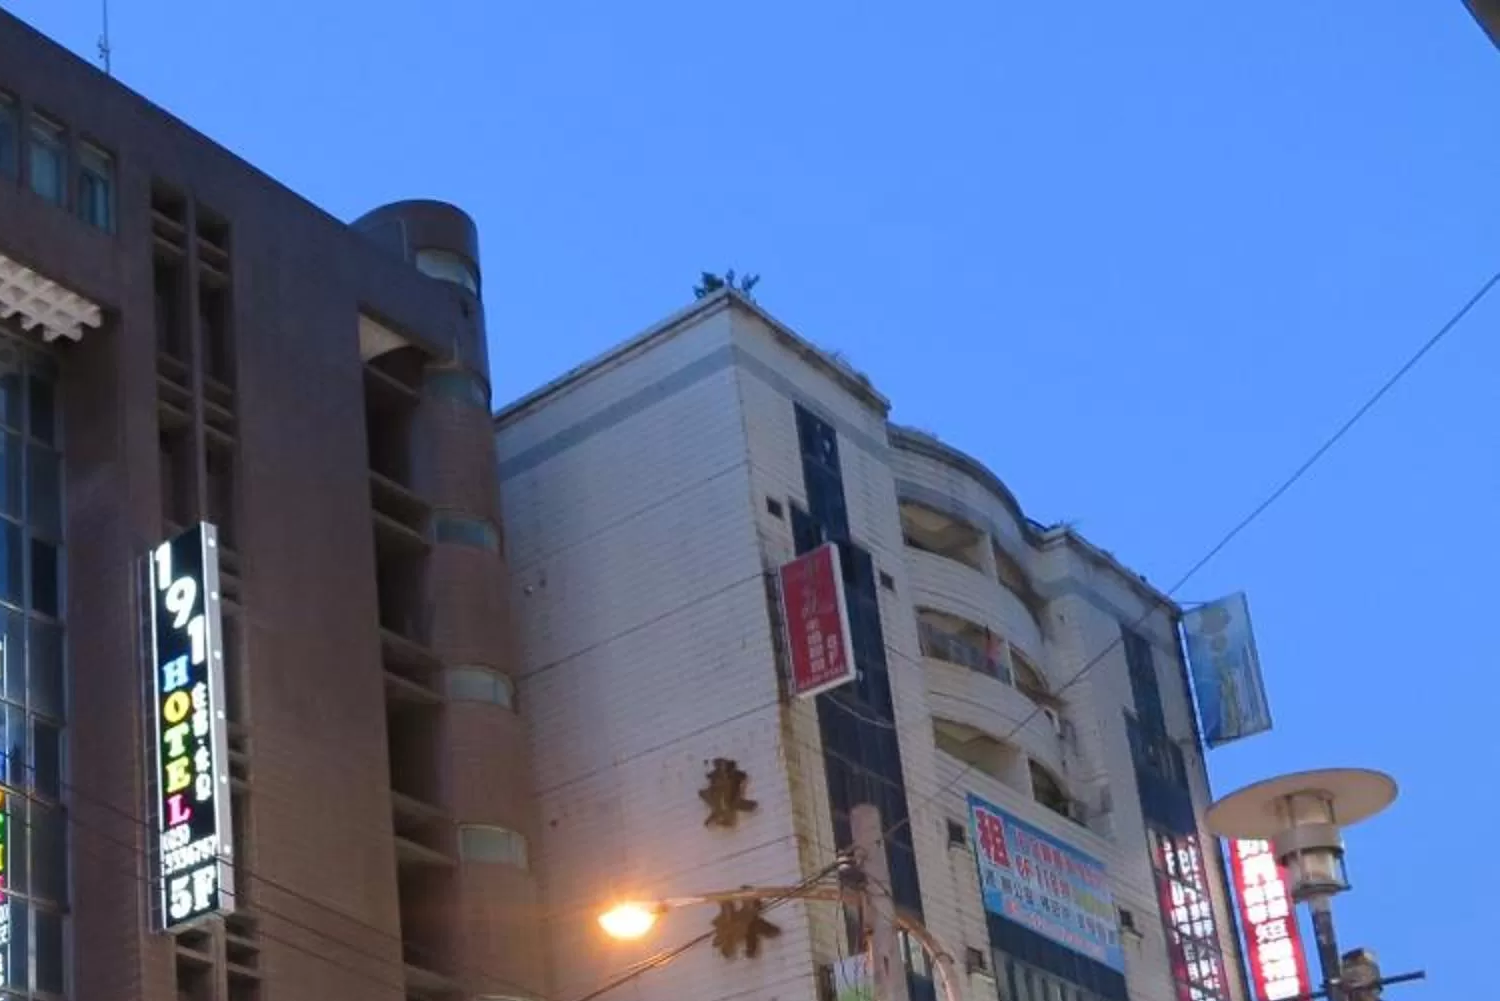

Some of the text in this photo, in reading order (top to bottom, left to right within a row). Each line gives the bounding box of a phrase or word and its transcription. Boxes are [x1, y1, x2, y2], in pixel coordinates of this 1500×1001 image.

[155, 541, 208, 665] 191
[162, 655, 192, 826] HOTEL
[169, 864, 216, 919] 5F
